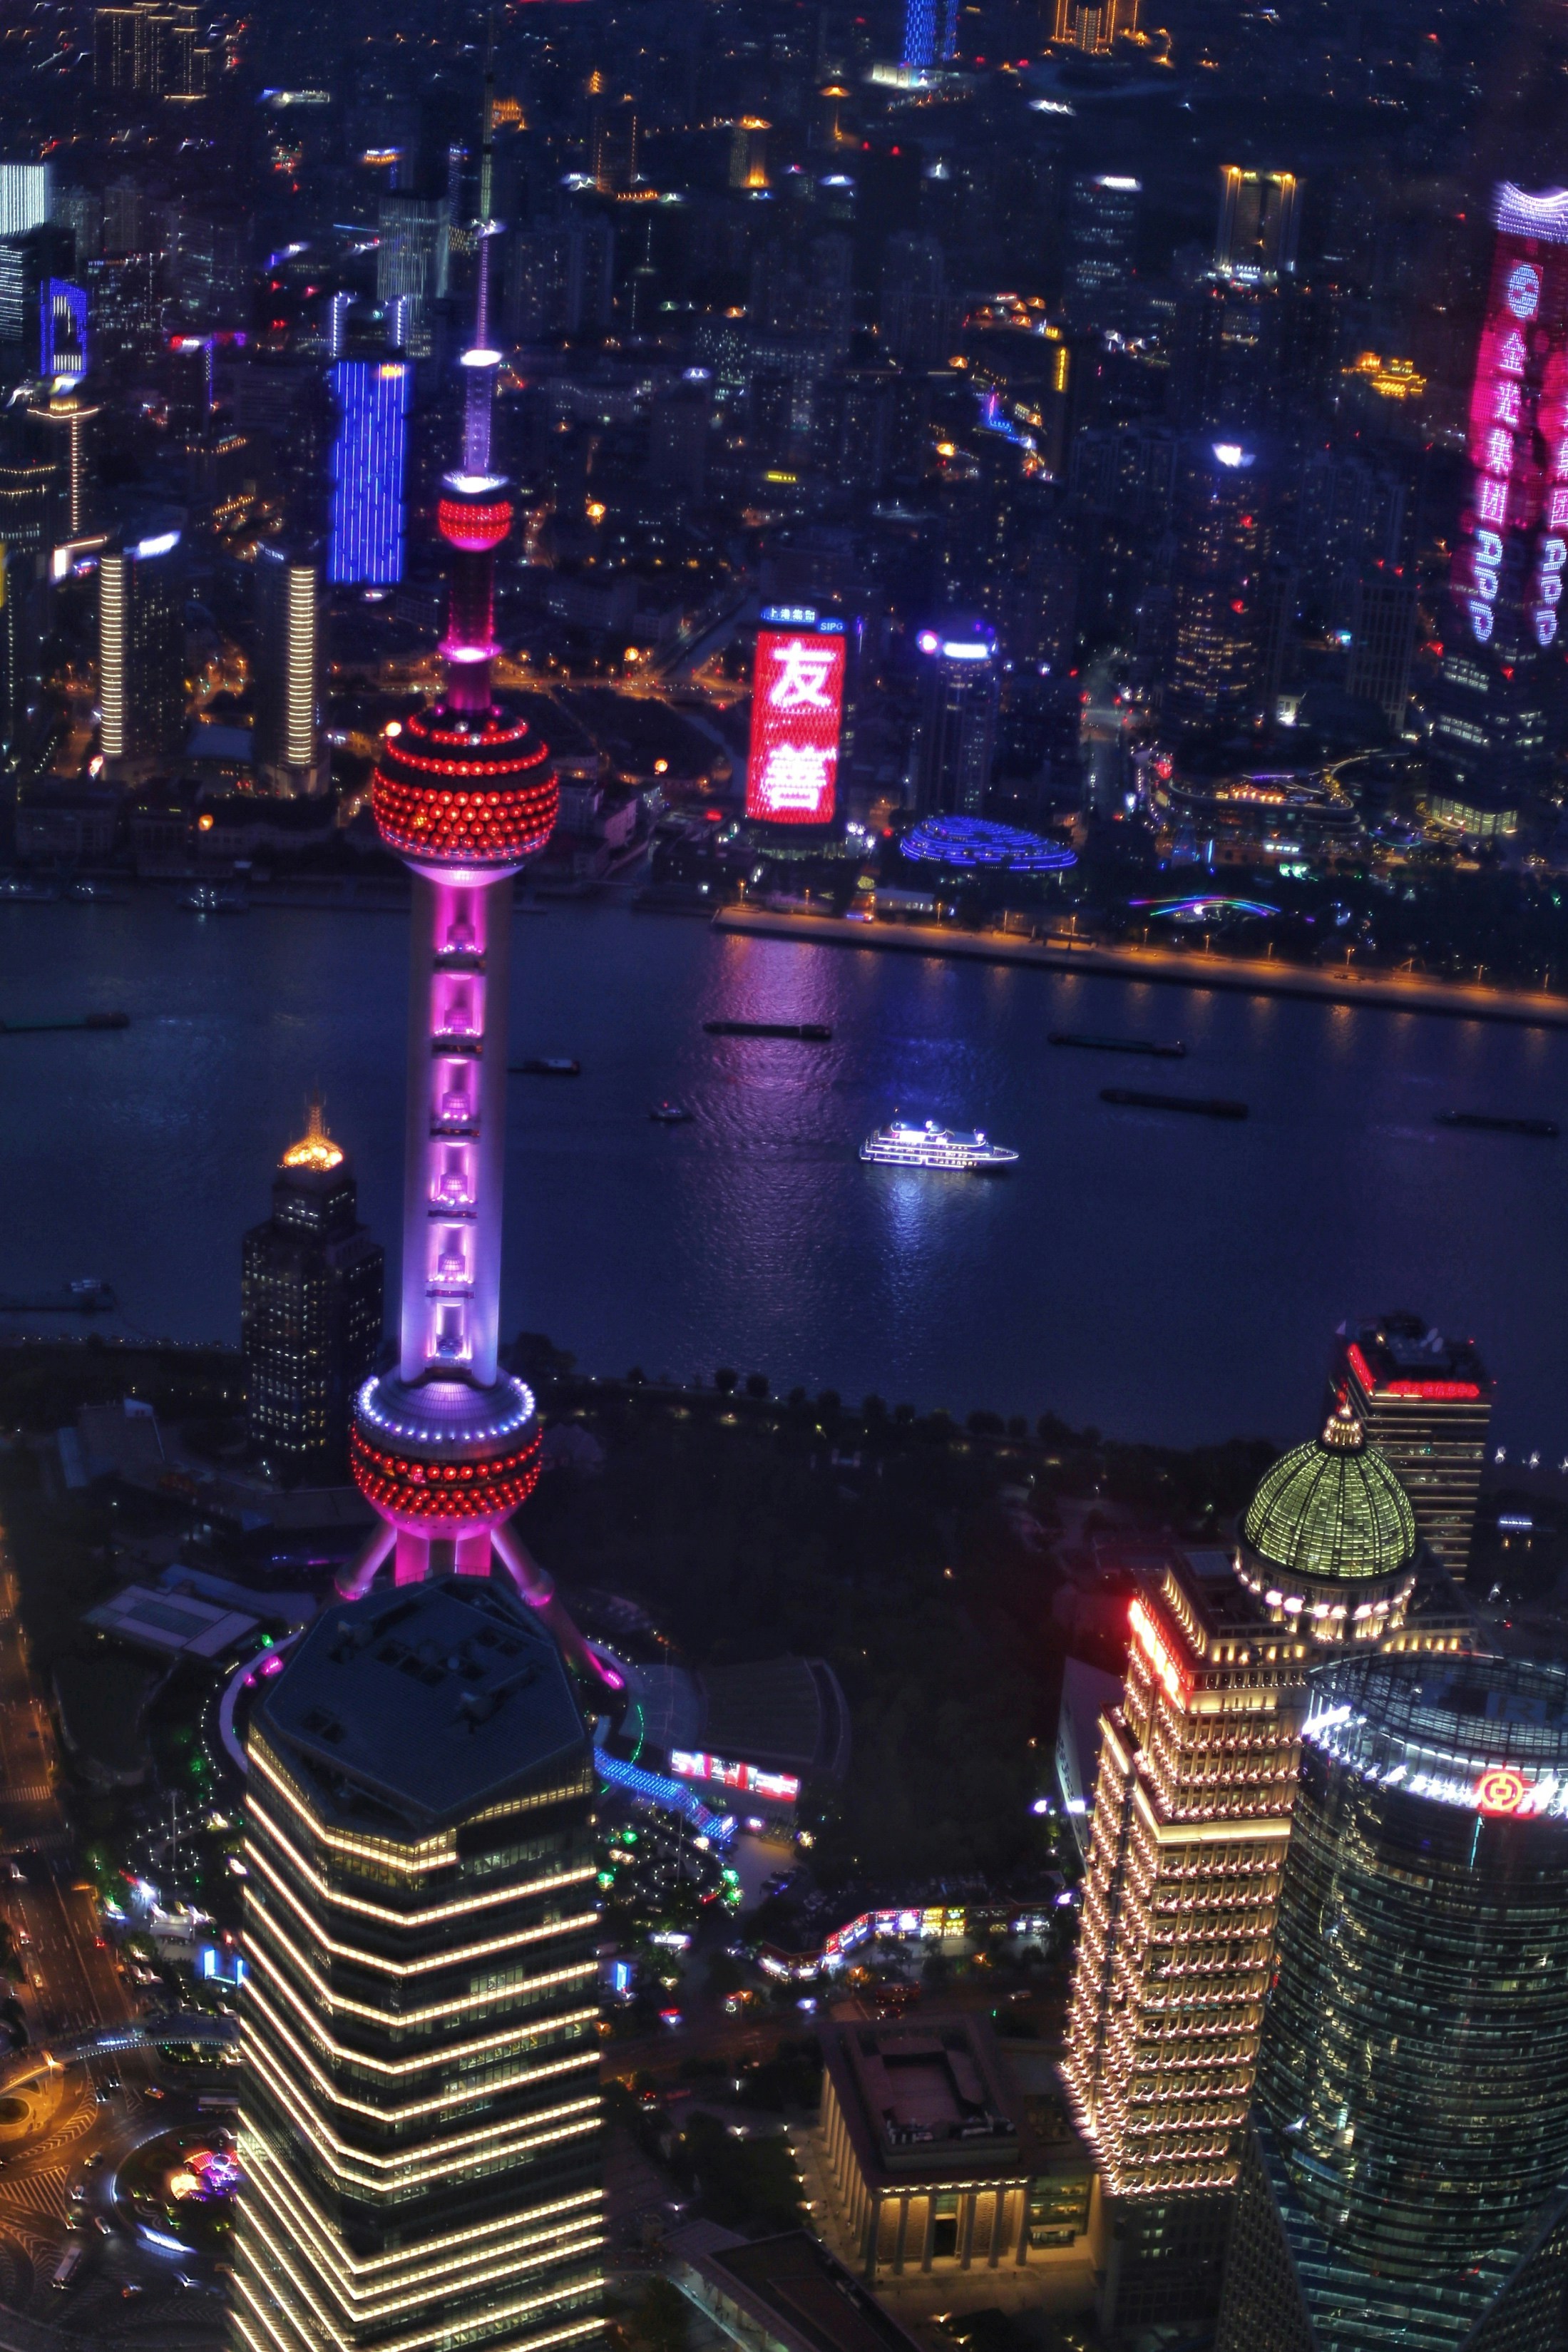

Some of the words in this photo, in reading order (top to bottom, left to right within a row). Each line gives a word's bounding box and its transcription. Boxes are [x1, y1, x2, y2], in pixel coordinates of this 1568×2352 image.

[820, 623, 844, 631] SIPG
[1469, 530, 1503, 642] APP
[1536, 540, 1567, 645] APP
[767, 640, 837, 811] 友善
